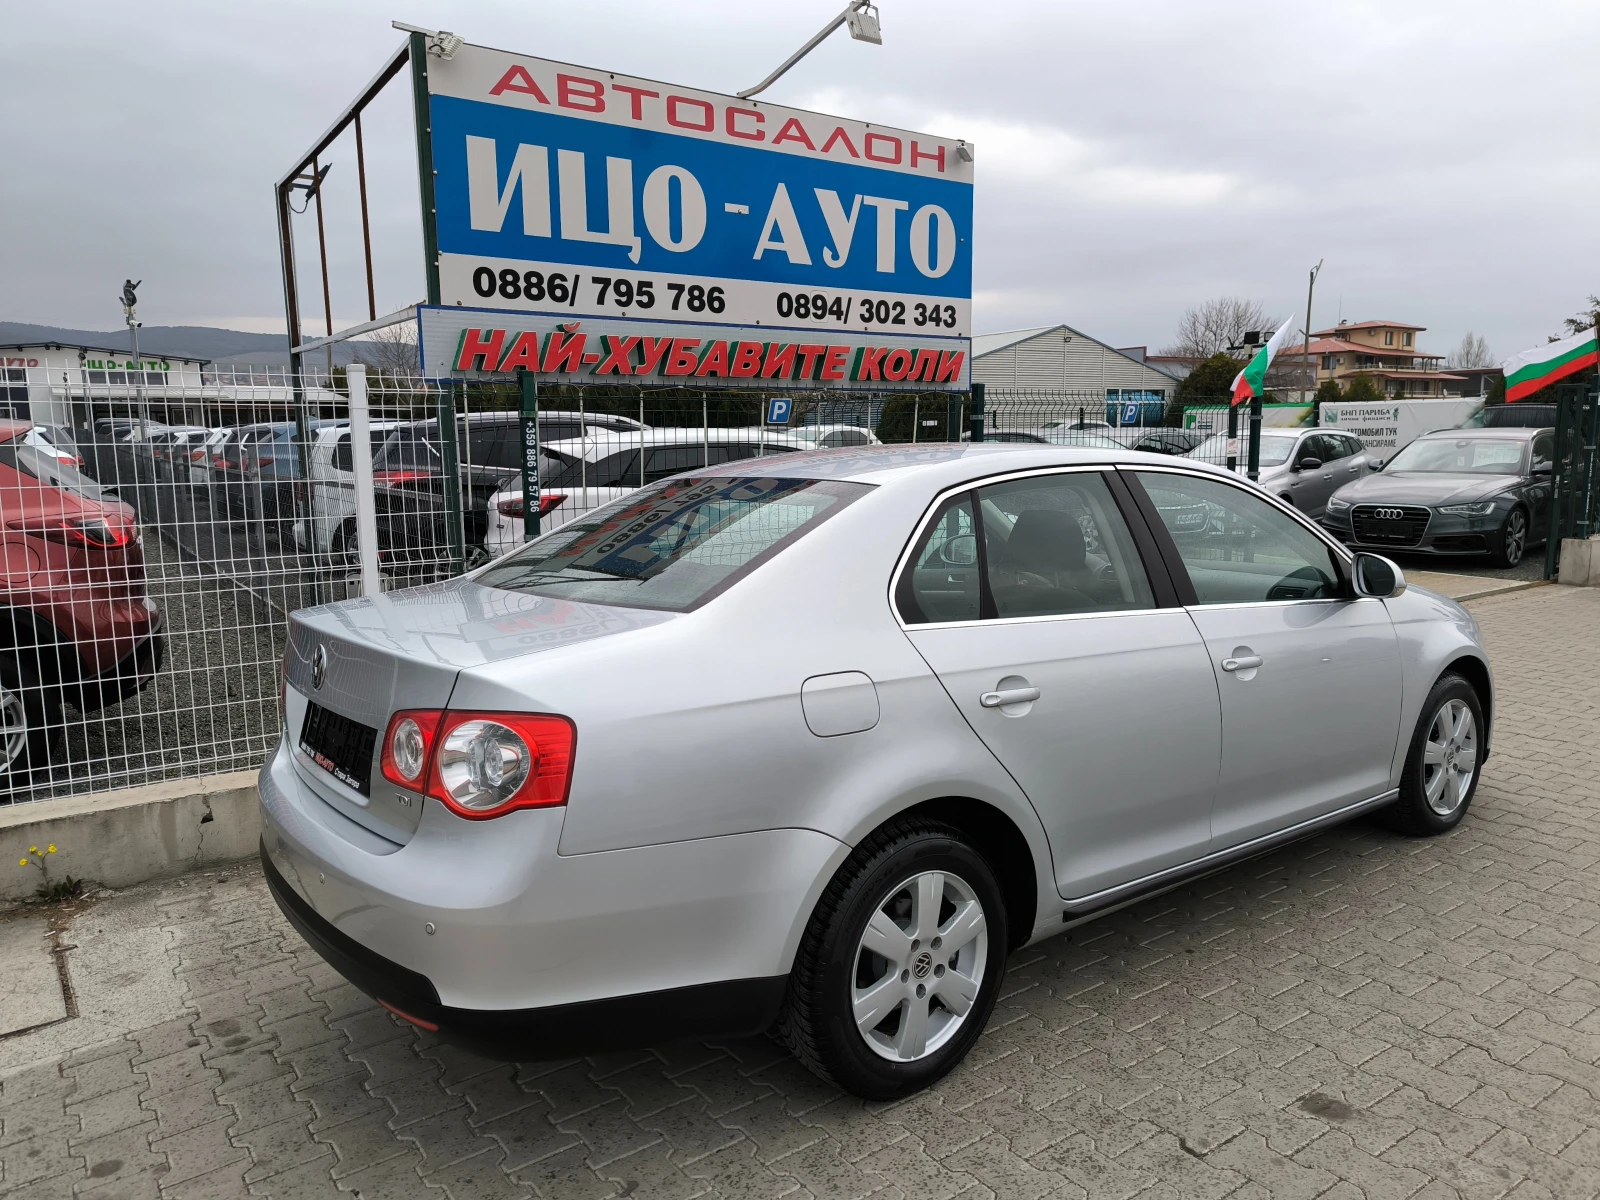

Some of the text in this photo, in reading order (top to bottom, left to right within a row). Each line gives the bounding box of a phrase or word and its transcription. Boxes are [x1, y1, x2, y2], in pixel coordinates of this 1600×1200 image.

[488, 64, 946, 172] АВТОСАЛОН
[472, 266, 957, 328] 0886/ 795 786 0894/ 302 343
[855, 345, 966, 383] КОЛИ
[772, 401, 787, 420] P
[1358, 408, 1391, 416] ПАРИБА
[1385, 427, 1398, 436] ТУК
[525, 420, 540, 513] +359 886 79 57 86
